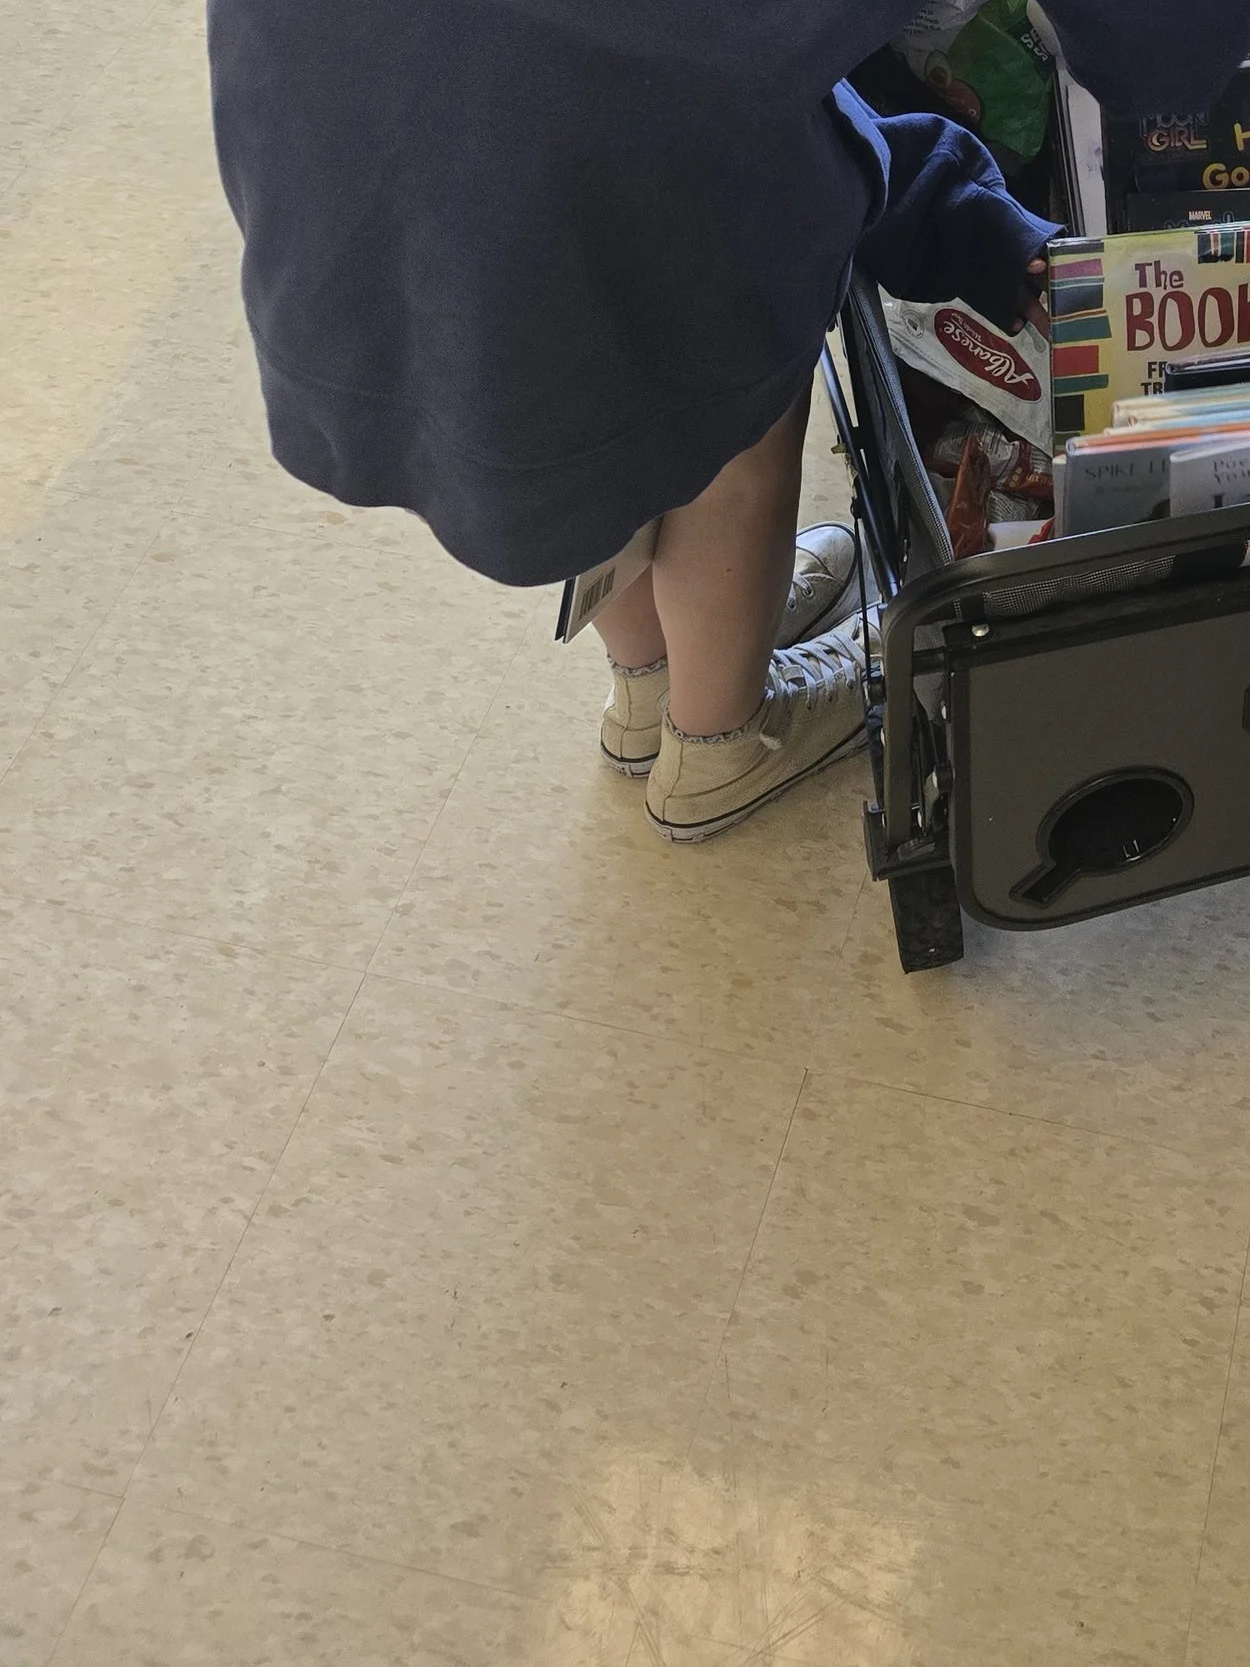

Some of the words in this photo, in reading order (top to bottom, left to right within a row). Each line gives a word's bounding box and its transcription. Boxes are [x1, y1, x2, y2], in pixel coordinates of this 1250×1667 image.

[1146, 128, 1207, 151] GIRL
[1188, 210, 1212, 221] MARVEL
[1134, 260, 1184, 291] The
[943, 320, 1035, 387] Albanese
